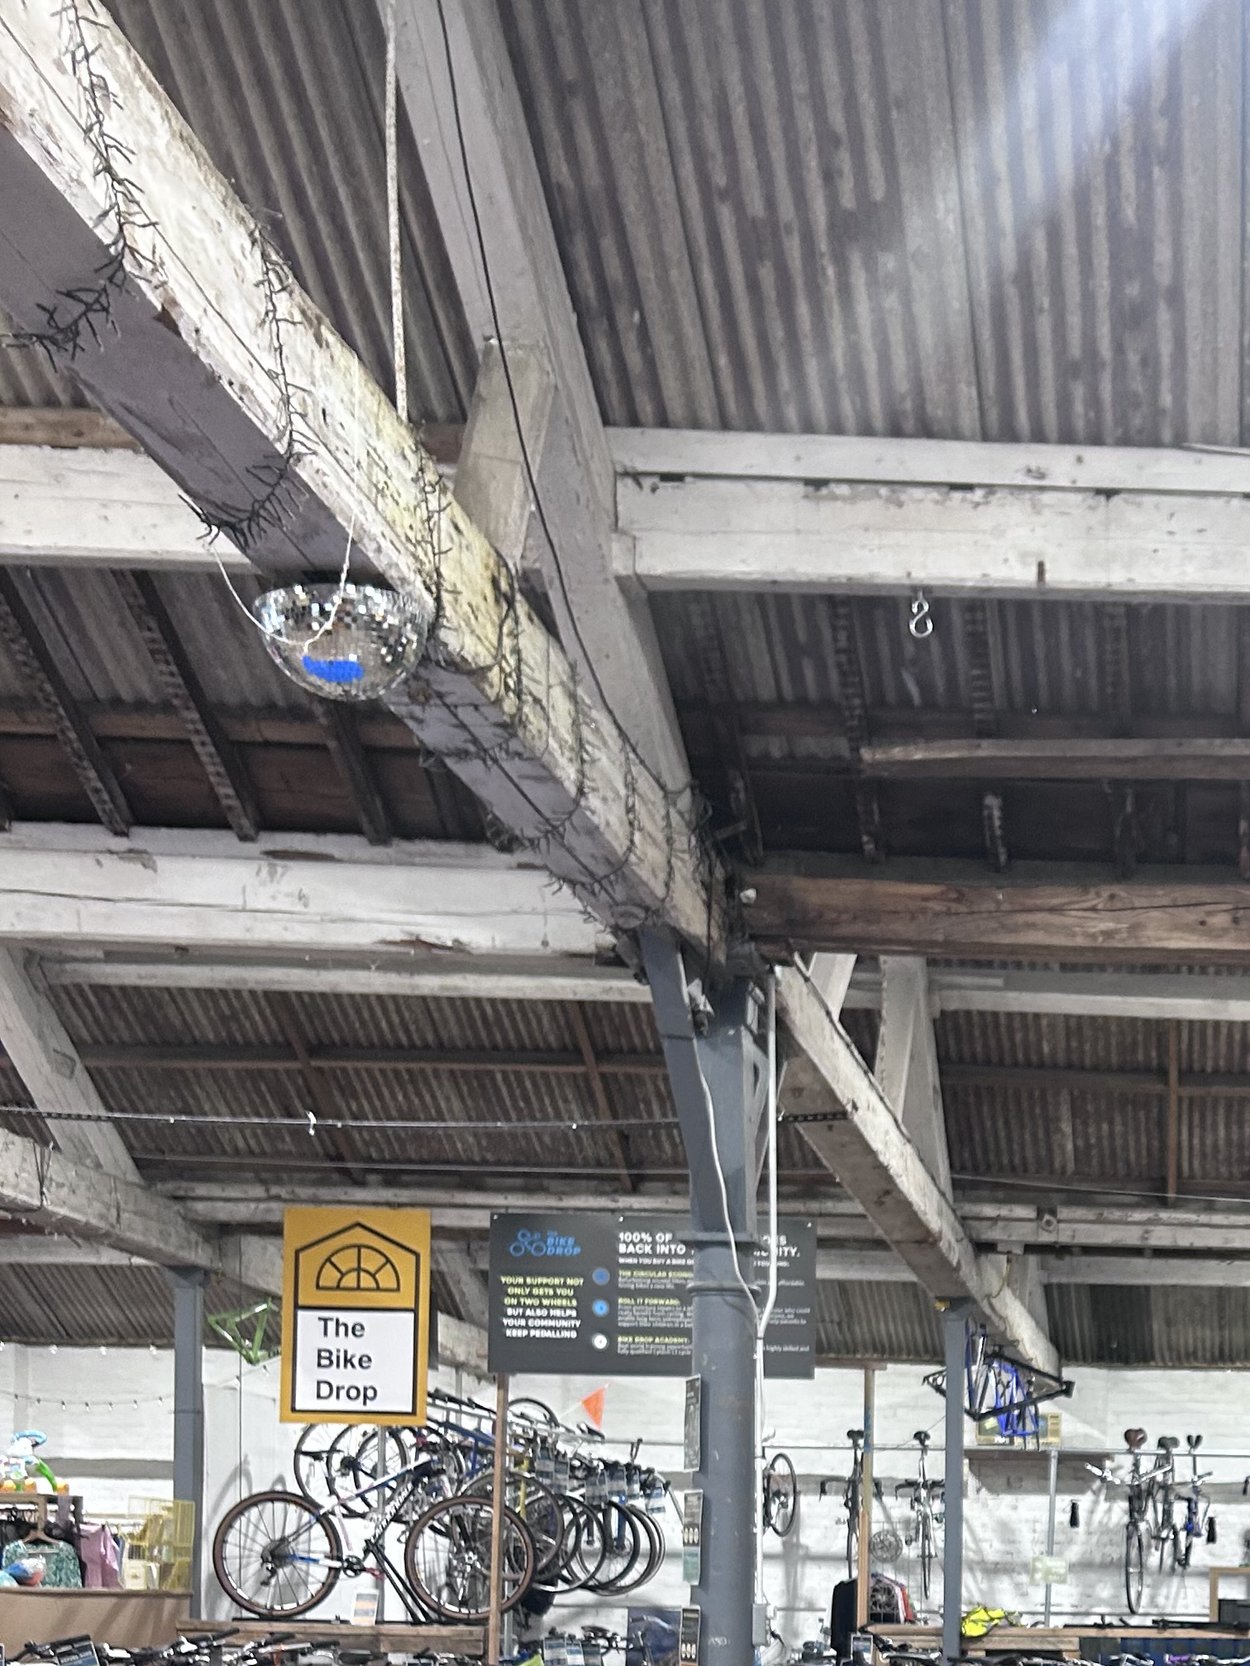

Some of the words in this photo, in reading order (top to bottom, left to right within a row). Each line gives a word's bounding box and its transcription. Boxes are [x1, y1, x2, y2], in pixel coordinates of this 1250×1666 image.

[619, 1231, 652, 1243] 100%
[655, 1231, 673, 1243] OF
[619, 1243, 652, 1255] BACK
[656, 1243, 686, 1255] INTO
[500, 1275, 524, 1285] YOUR
[526, 1276, 564, 1286] SUPPORT
[566, 1277, 584, 1286] NOT
[508, 1287, 530, 1295] ONLY
[556, 1288, 574, 1296] YOU
[504, 1297, 517, 1305] ON
[520, 1297, 540, 1306] TWO
[542, 1298, 577, 1307] WHEELS
[507, 1307, 523, 1316] BUT
[525, 1308, 548, 1317] ALSO
[550, 1308, 577, 1317] HELPS
[318, 1316, 365, 1338] The
[503, 1318, 526, 1327] YOUR
[528, 1318, 581, 1328] COMMUNITY
[506, 1328, 529, 1337] KEEP
[530, 1329, 577, 1339] PEDALLING
[317, 1348, 372, 1369] Bike
[316, 1380, 378, 1406] Drop
